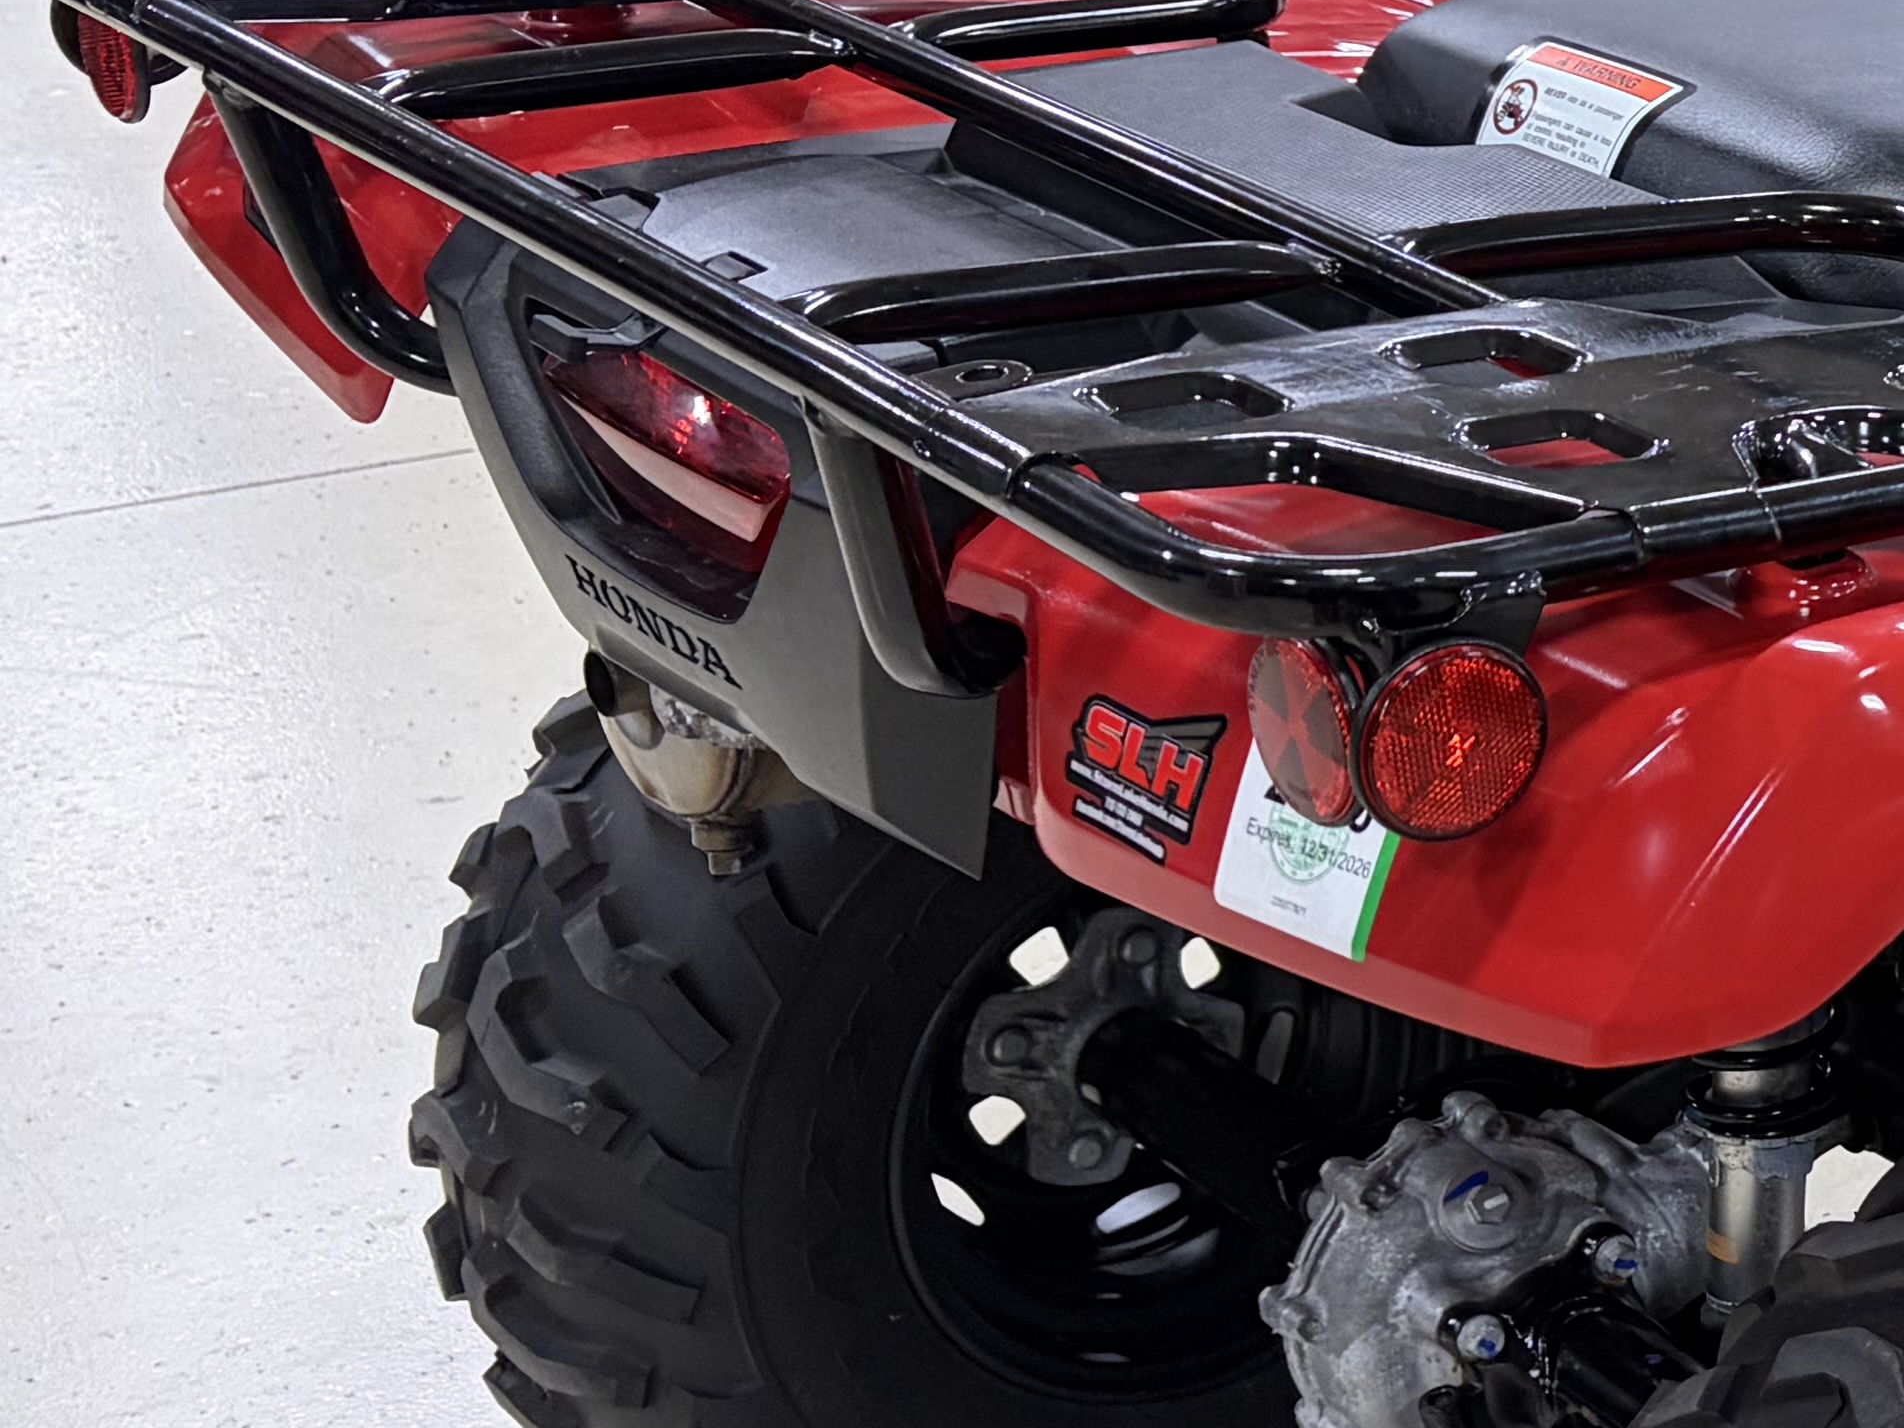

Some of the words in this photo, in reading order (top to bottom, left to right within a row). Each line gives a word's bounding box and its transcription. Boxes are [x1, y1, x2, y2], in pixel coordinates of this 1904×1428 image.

[1573, 59, 1641, 89] WARNING
[564, 553, 743, 690] HONDA
[1085, 705, 1205, 813] SLH
[1300, 837, 1373, 880] 12/31/2026
